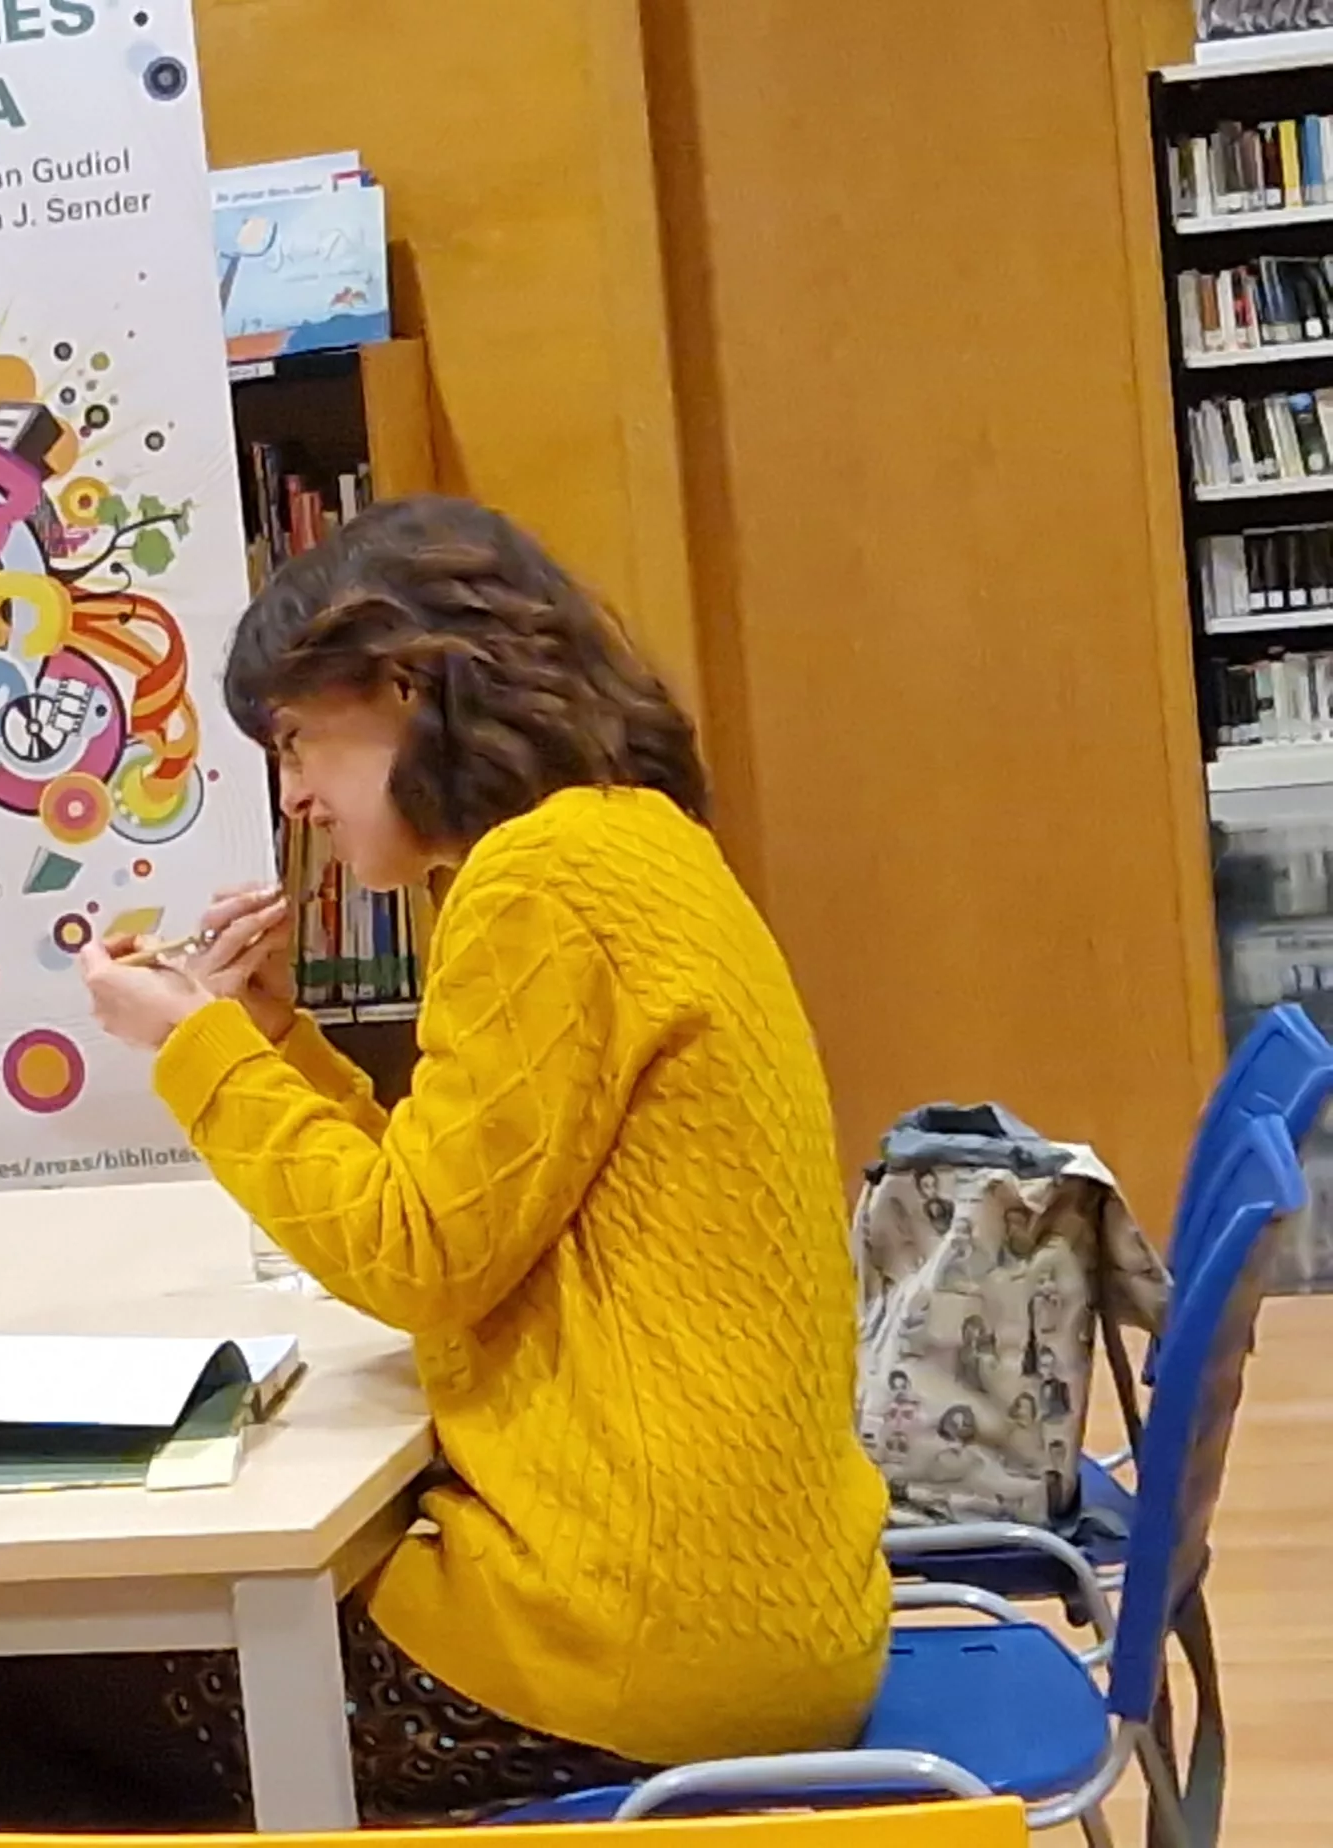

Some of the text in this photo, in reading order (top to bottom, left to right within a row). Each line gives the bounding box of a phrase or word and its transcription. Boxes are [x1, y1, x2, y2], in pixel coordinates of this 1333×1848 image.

[33, 147, 131, 184] Gudiol
[12, 201, 37, 228] J.
[46, 190, 152, 224] Sender
